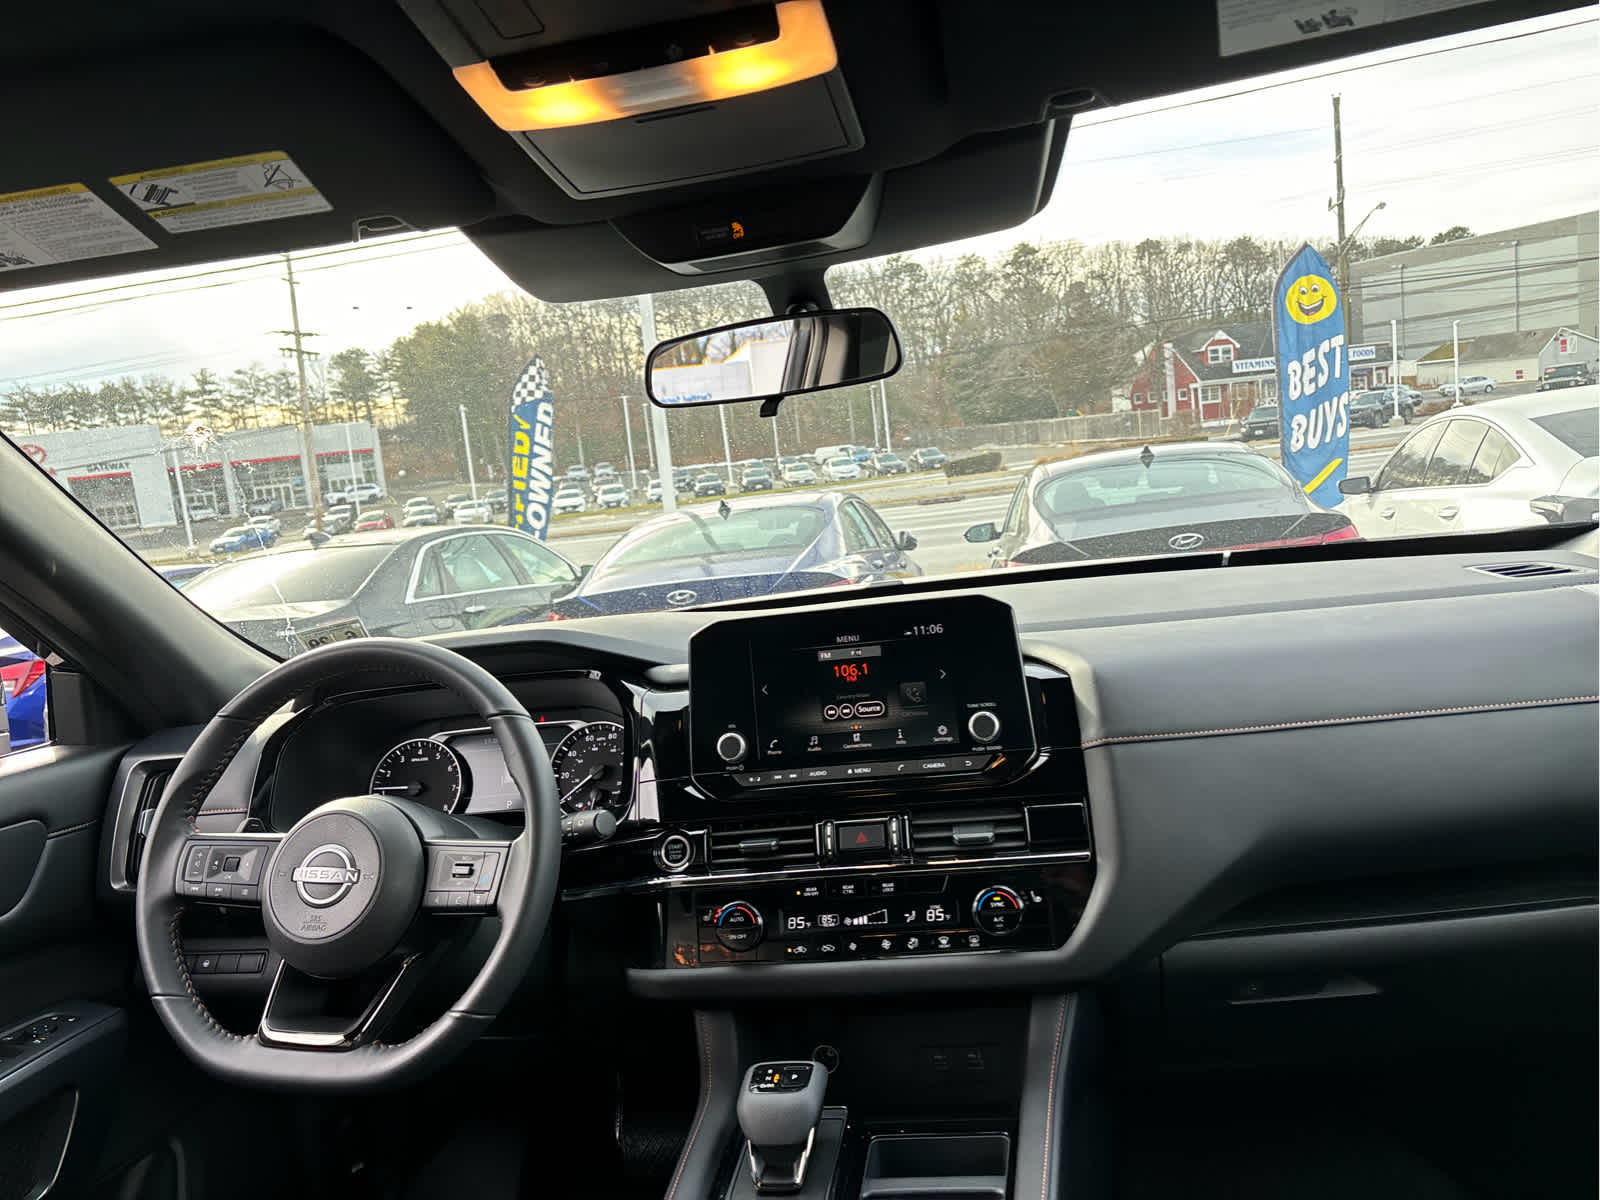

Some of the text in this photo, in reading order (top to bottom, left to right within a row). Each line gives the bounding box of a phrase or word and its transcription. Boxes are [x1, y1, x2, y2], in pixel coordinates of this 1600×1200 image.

[1352, 350, 1375, 358] FOODS
[1234, 360, 1275, 370] VITAMINS
[1288, 334, 1344, 401] BEST
[1290, 391, 1348, 453] BUYS
[913, 623, 943, 636] 11:06
[836, 635, 860, 643] MENU
[833, 663, 869, 678] 106.1
[858, 704, 881, 713] Source
[506, 800, 513, 809] P
[294, 868, 358, 882] NISSAN
